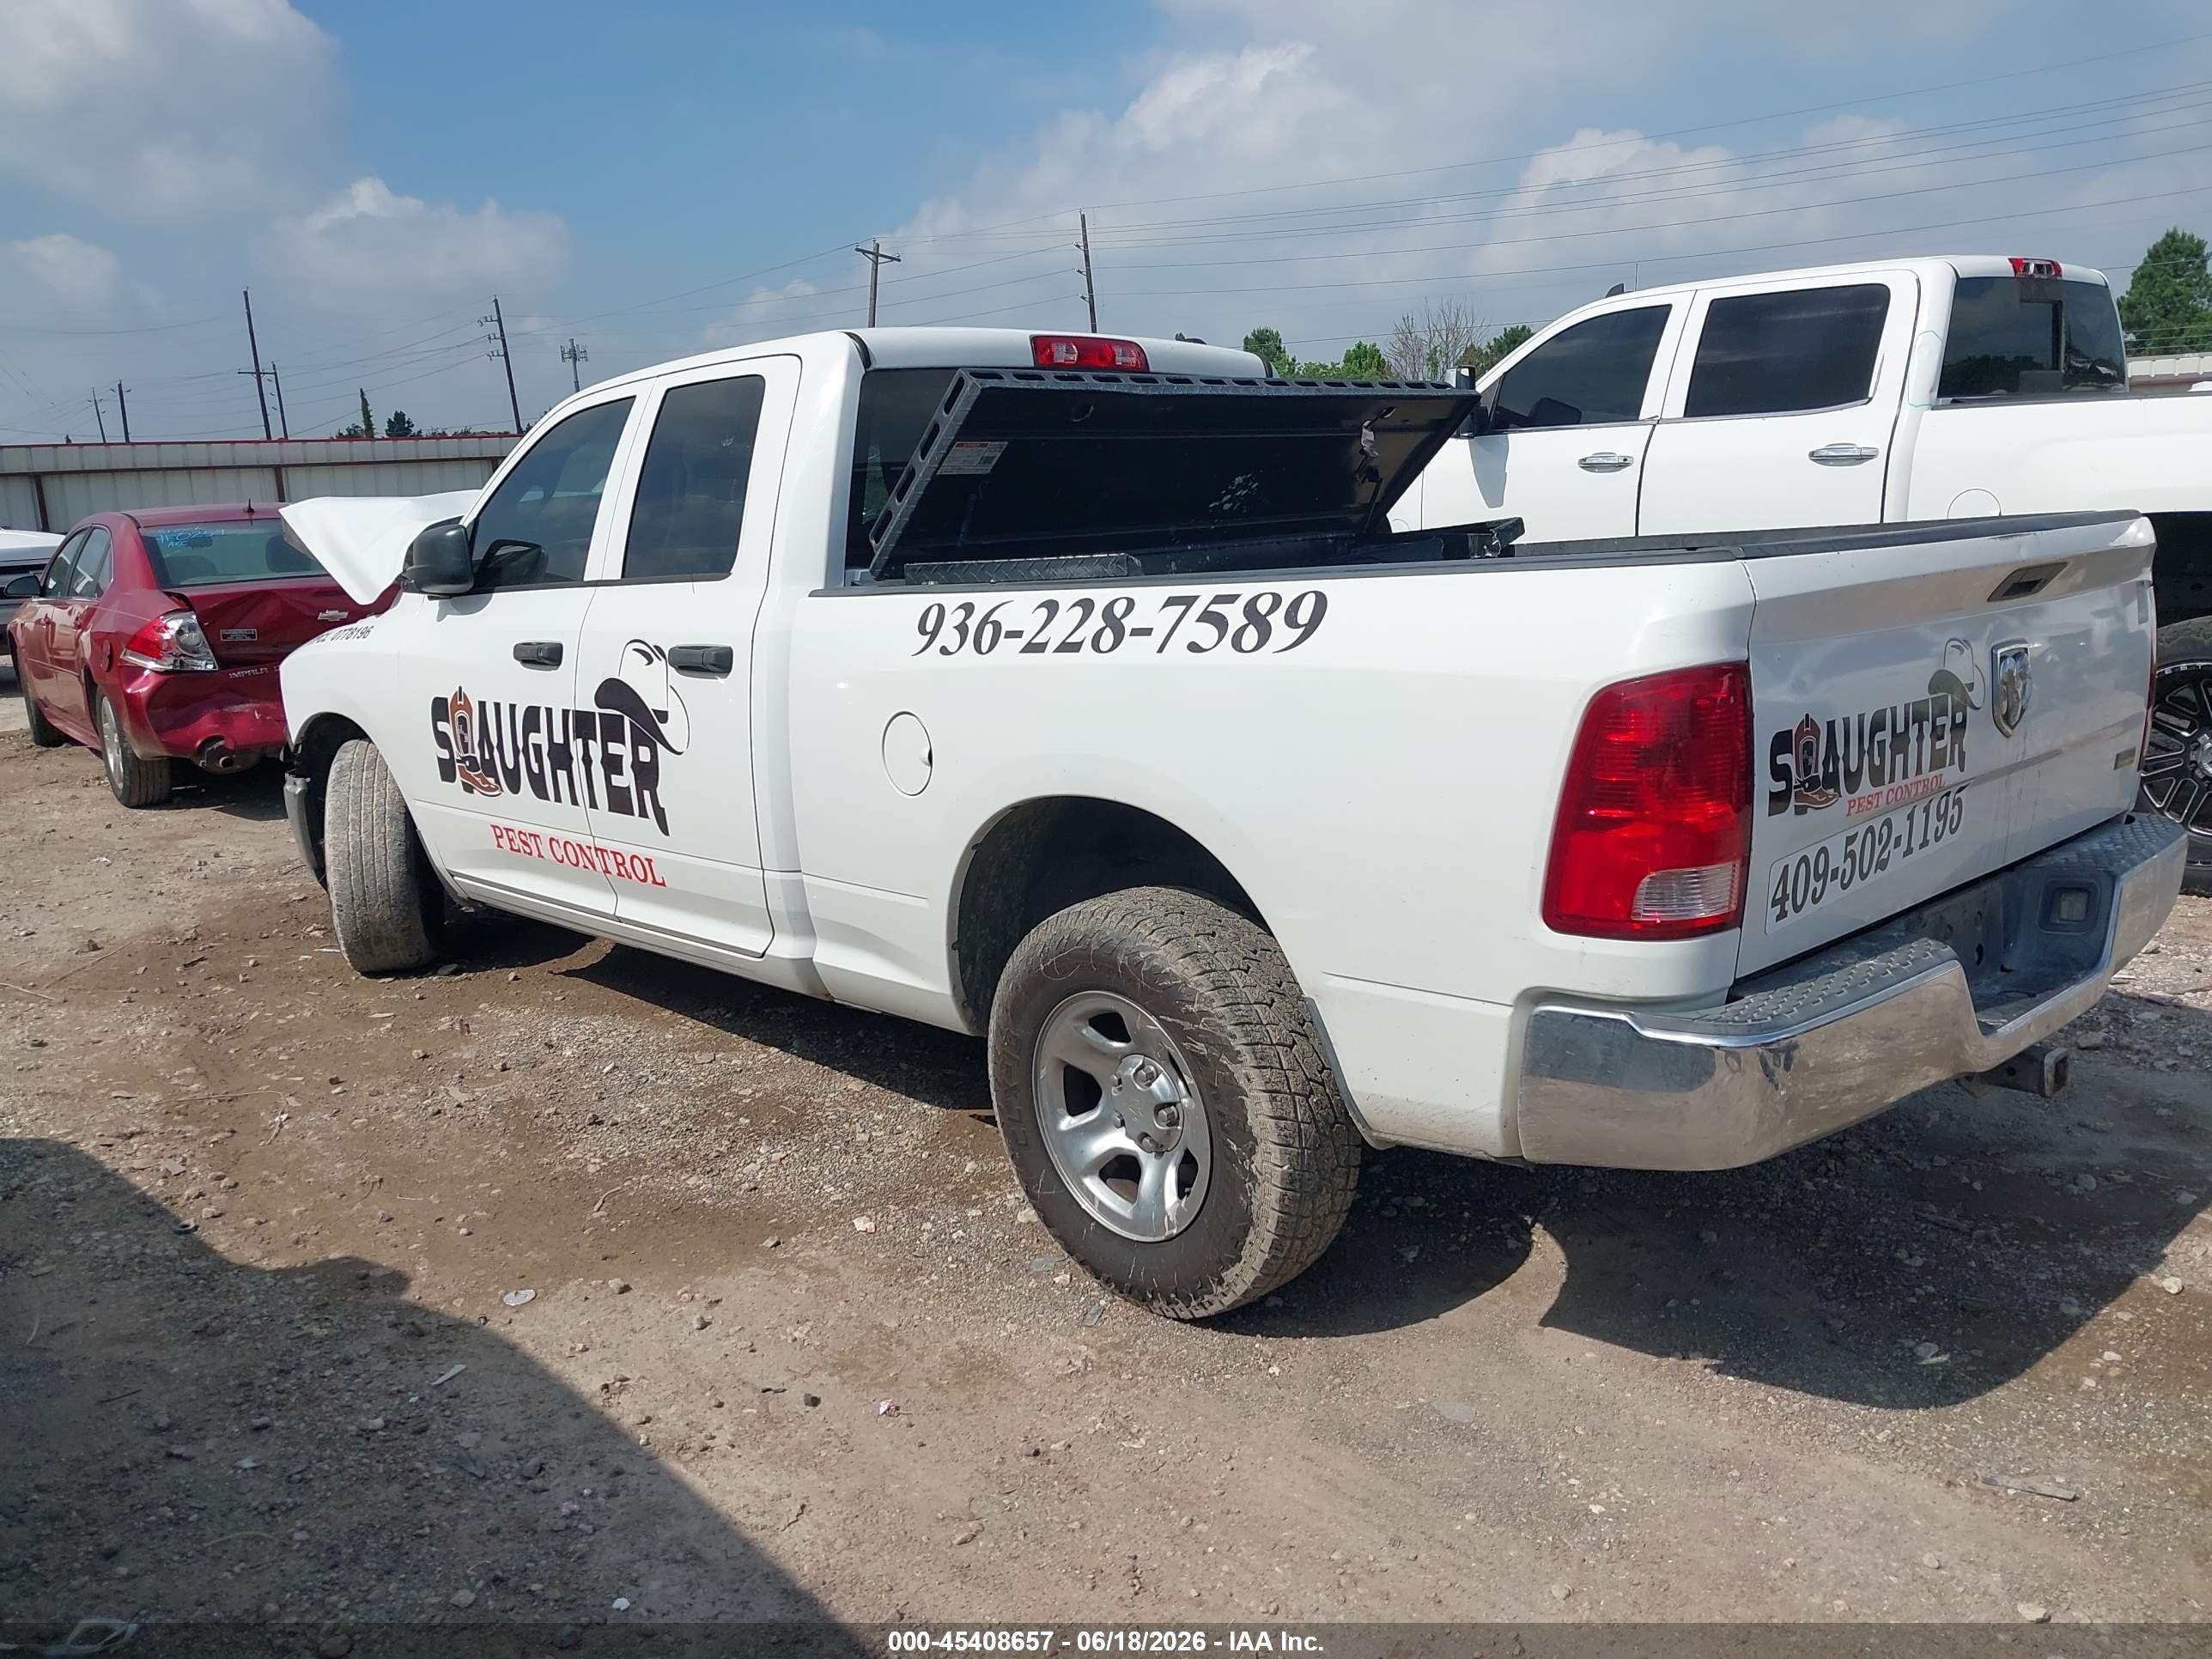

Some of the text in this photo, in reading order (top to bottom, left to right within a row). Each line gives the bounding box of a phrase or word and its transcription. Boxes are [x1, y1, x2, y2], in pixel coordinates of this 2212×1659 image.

[911, 590, 1328, 656] 936-228-7589
[228, 667, 269, 679] IMPALA
[430, 685, 671, 837] SLAUGHTER
[1767, 692, 1968, 817] SLAUGHTER
[1845, 773, 1946, 817] PEST CONTROL
[489, 823, 667, 888] PEST CONTROL
[1771, 782, 1973, 923] 409-502-1195
